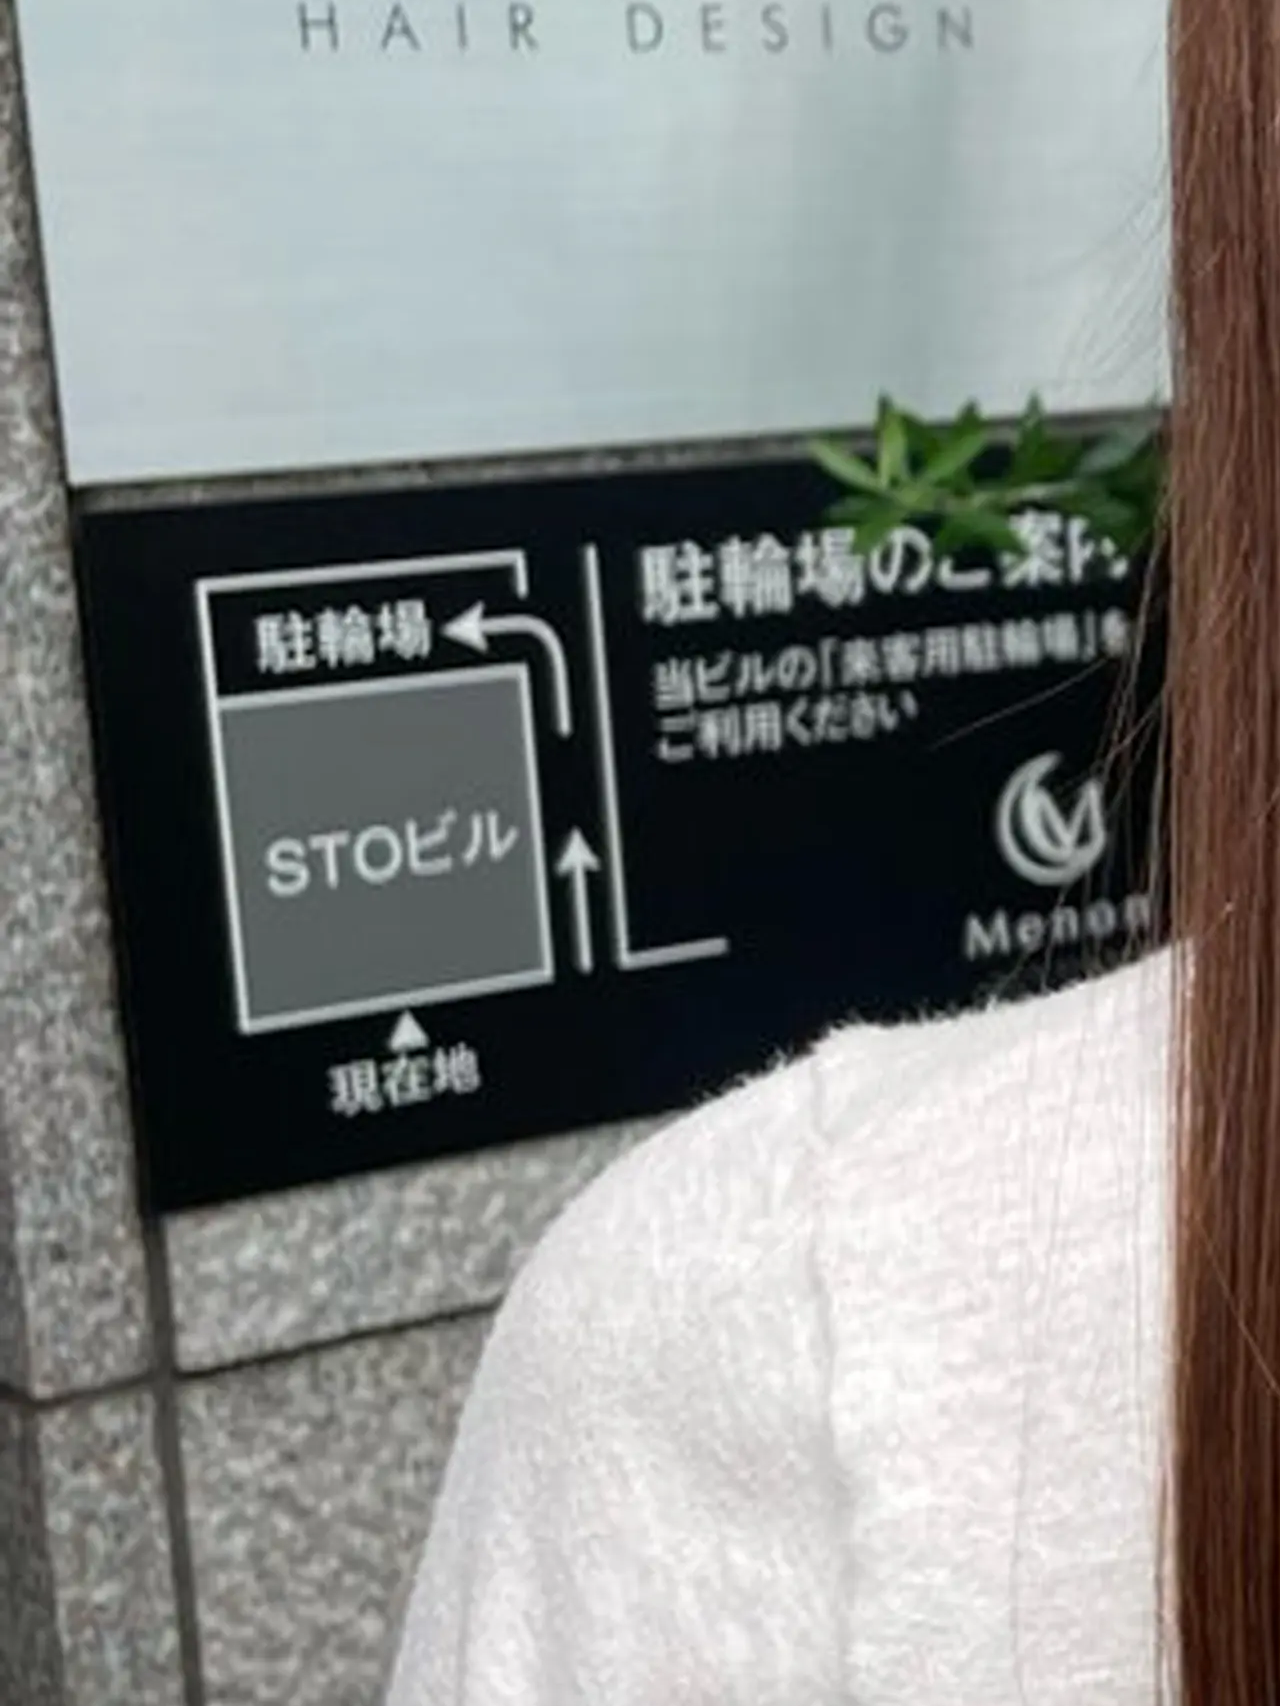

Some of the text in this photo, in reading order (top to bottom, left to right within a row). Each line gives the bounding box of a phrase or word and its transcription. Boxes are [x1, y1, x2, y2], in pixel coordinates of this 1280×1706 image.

[297, 1, 975, 55] HAIR DESIGN
[255, 599, 432, 675] 駐輪場
[658, 690, 920, 763] ご利用ください
[265, 808, 519, 897] STOビル
[328, 1042, 481, 1117] 現在地
